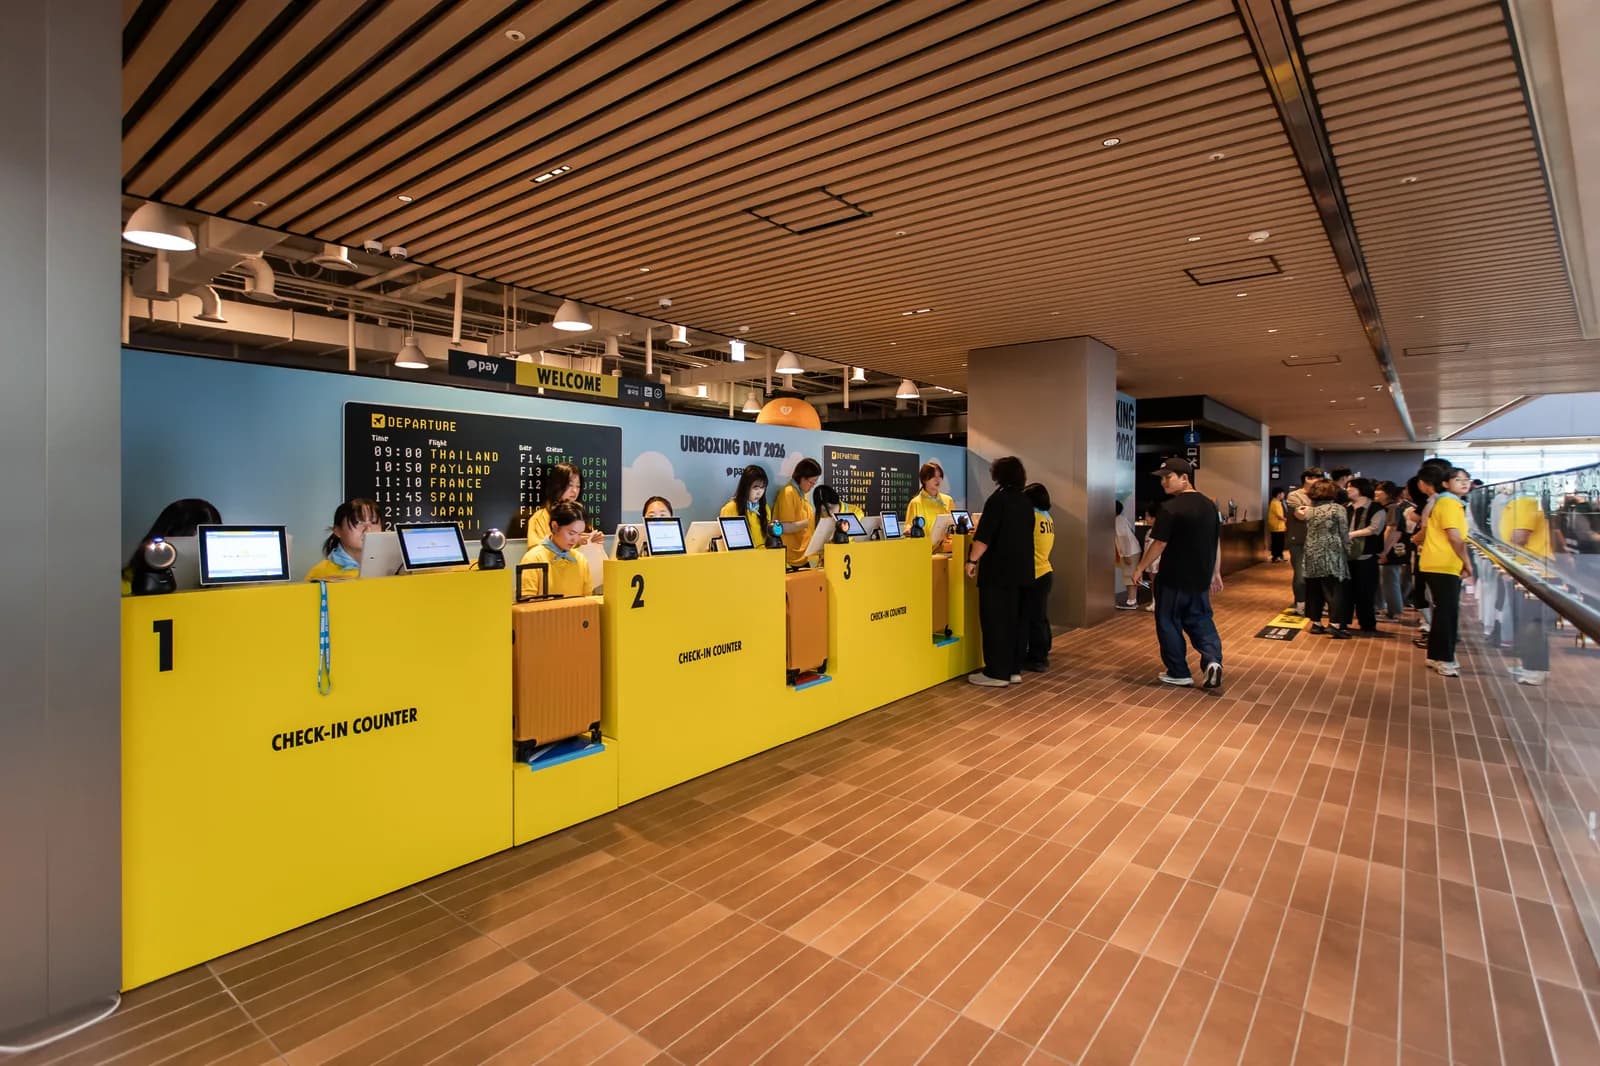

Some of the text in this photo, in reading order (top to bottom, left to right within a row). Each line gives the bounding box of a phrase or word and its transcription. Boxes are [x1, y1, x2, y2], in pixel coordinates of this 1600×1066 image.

[478, 359, 499, 374] pay
[537, 367, 601, 392] WELCOME
[388, 416, 457, 432] DEPARTURE
[374, 446, 422, 458] 09:00
[430, 448, 499, 462] THAILAND
[520, 453, 541, 463] F14
[582, 457, 607, 466] OPEN
[680, 434, 786, 458] UNBOXING DAY 2026
[1116, 432, 1134, 461] 2026
[375, 461, 422, 473] 10:50
[430, 463, 490, 475] PAYLAND
[520, 466, 541, 477] F13
[582, 469, 607, 478] OPEN
[375, 476, 422, 488] 11:10
[430, 477, 482, 489] FRANCE
[520, 479, 541, 490] F12
[375, 491, 607, 502] 11:45 SPAIN F11 OPEN
[385, 506, 422, 517] 2:10
[430, 506, 473, 517] JAPAN
[843, 554, 851, 580] 3
[631, 574, 644, 609] 2
[870, 606, 907, 621] CHECK-IN COUNTER
[153, 619, 173, 672] 1
[678, 640, 742, 664] CHECK-IN COUNTER
[271, 707, 418, 751] CHECK-IN COUNTER
